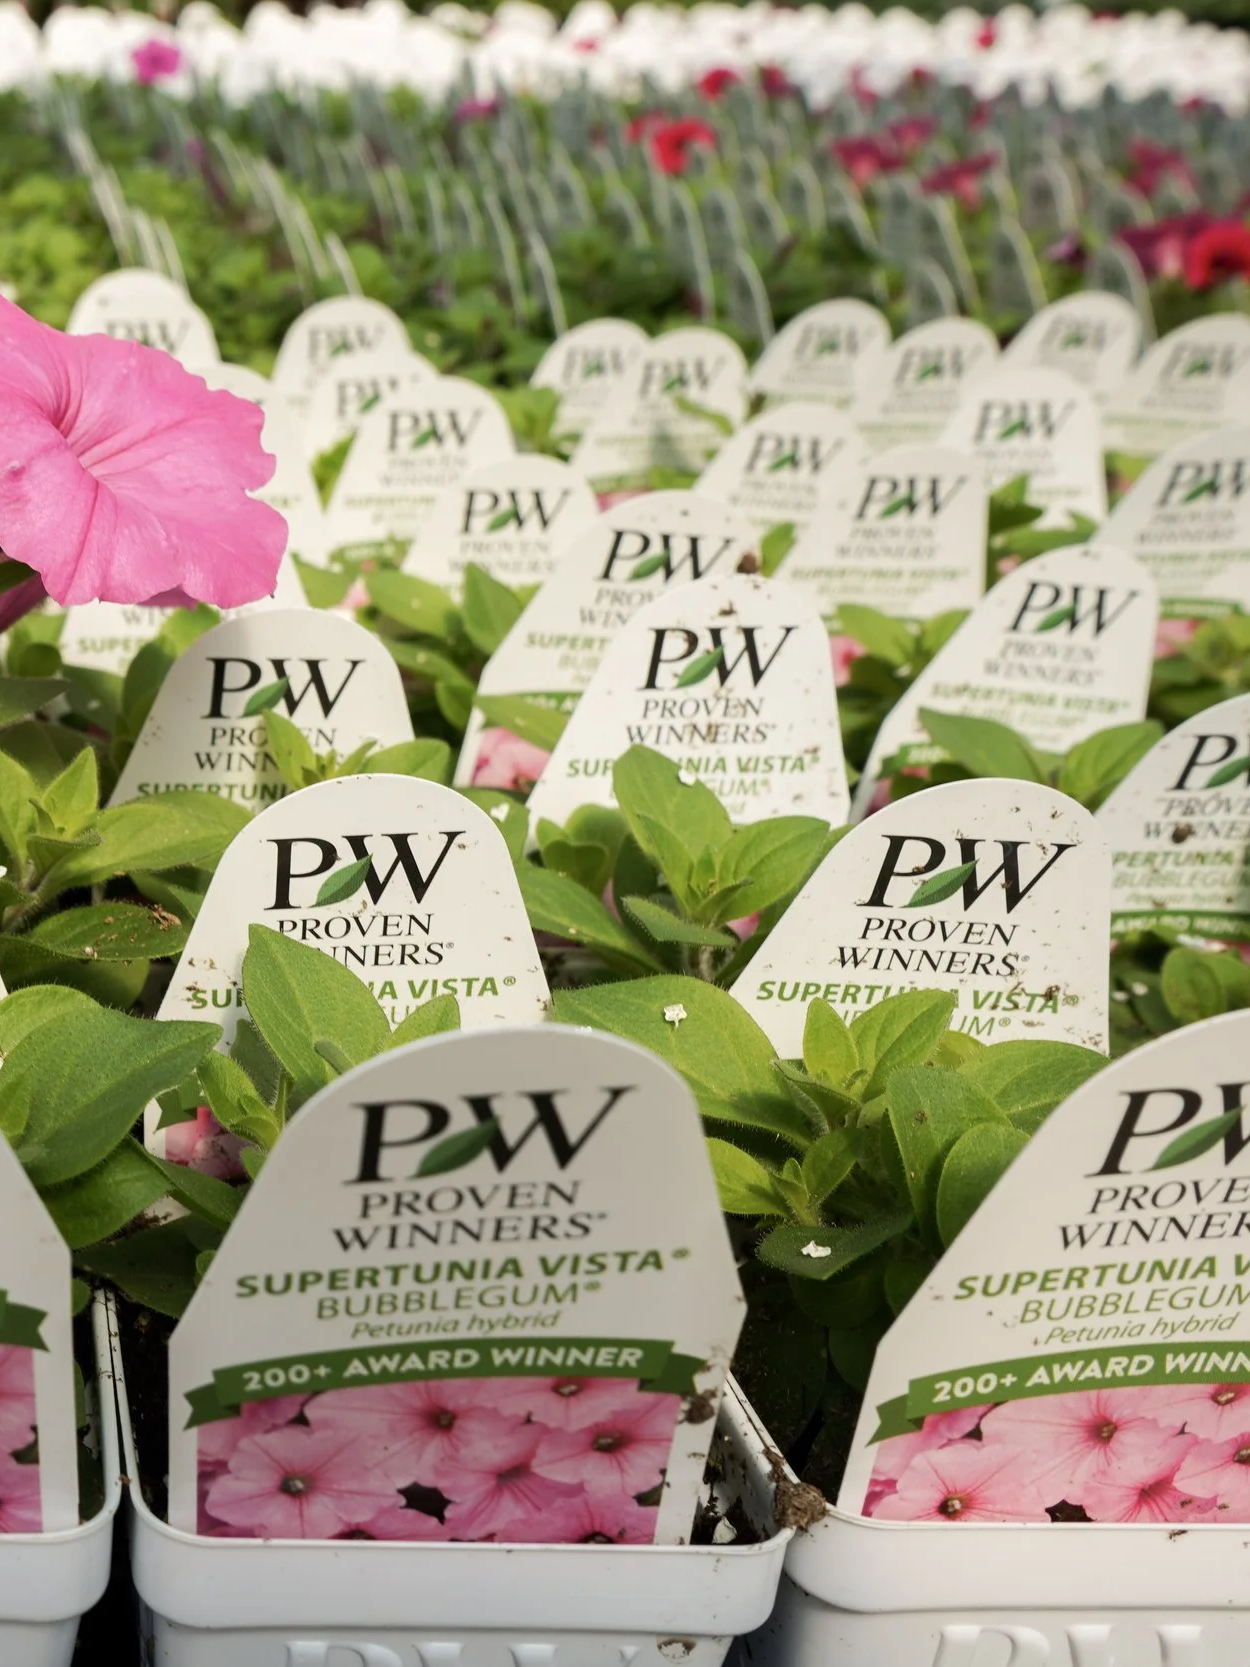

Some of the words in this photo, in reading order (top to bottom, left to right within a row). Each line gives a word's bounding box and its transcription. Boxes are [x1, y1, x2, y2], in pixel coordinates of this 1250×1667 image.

[460, 488, 572, 534] PW
[853, 473, 970, 521] PW
[594, 527, 736, 584] PW
[1005, 577, 1141, 640] PW
[637, 624, 800, 693] PW
[200, 655, 368, 721] PW
[642, 698, 764, 719] PROVEN
[210, 726, 338, 748] PRON
[1165, 734, 1250, 792] P
[263, 830, 467, 912] PW
[856, 833, 1077, 915] PW
[276, 913, 435, 941] PROVEN
[859, 916, 1021, 947] PROVEN
[343, 1083, 643, 1186] PW
[1084, 1081, 1250, 1179] P
[358, 1179, 582, 1220] PROVEN
[1087, 1175, 1250, 1215] PROVE
[235, 1255, 524, 1299] SUPERTUNIA
[953, 1254, 1218, 1301] SUPERTUNIA
[350, 1313, 461, 1341] Petunia
[465, 1309, 563, 1337] hybrid
[1043, 1319, 1147, 1346] Petunia
[1150, 1311, 1241, 1343] hybrid
[241, 1363, 334, 1391] 200+
[341, 1348, 482, 1378] AWARD
[488, 1346, 645, 1372] WINNER
[933, 1374, 1018, 1401] 200+
[1024, 1353, 1156, 1388] AWARD
